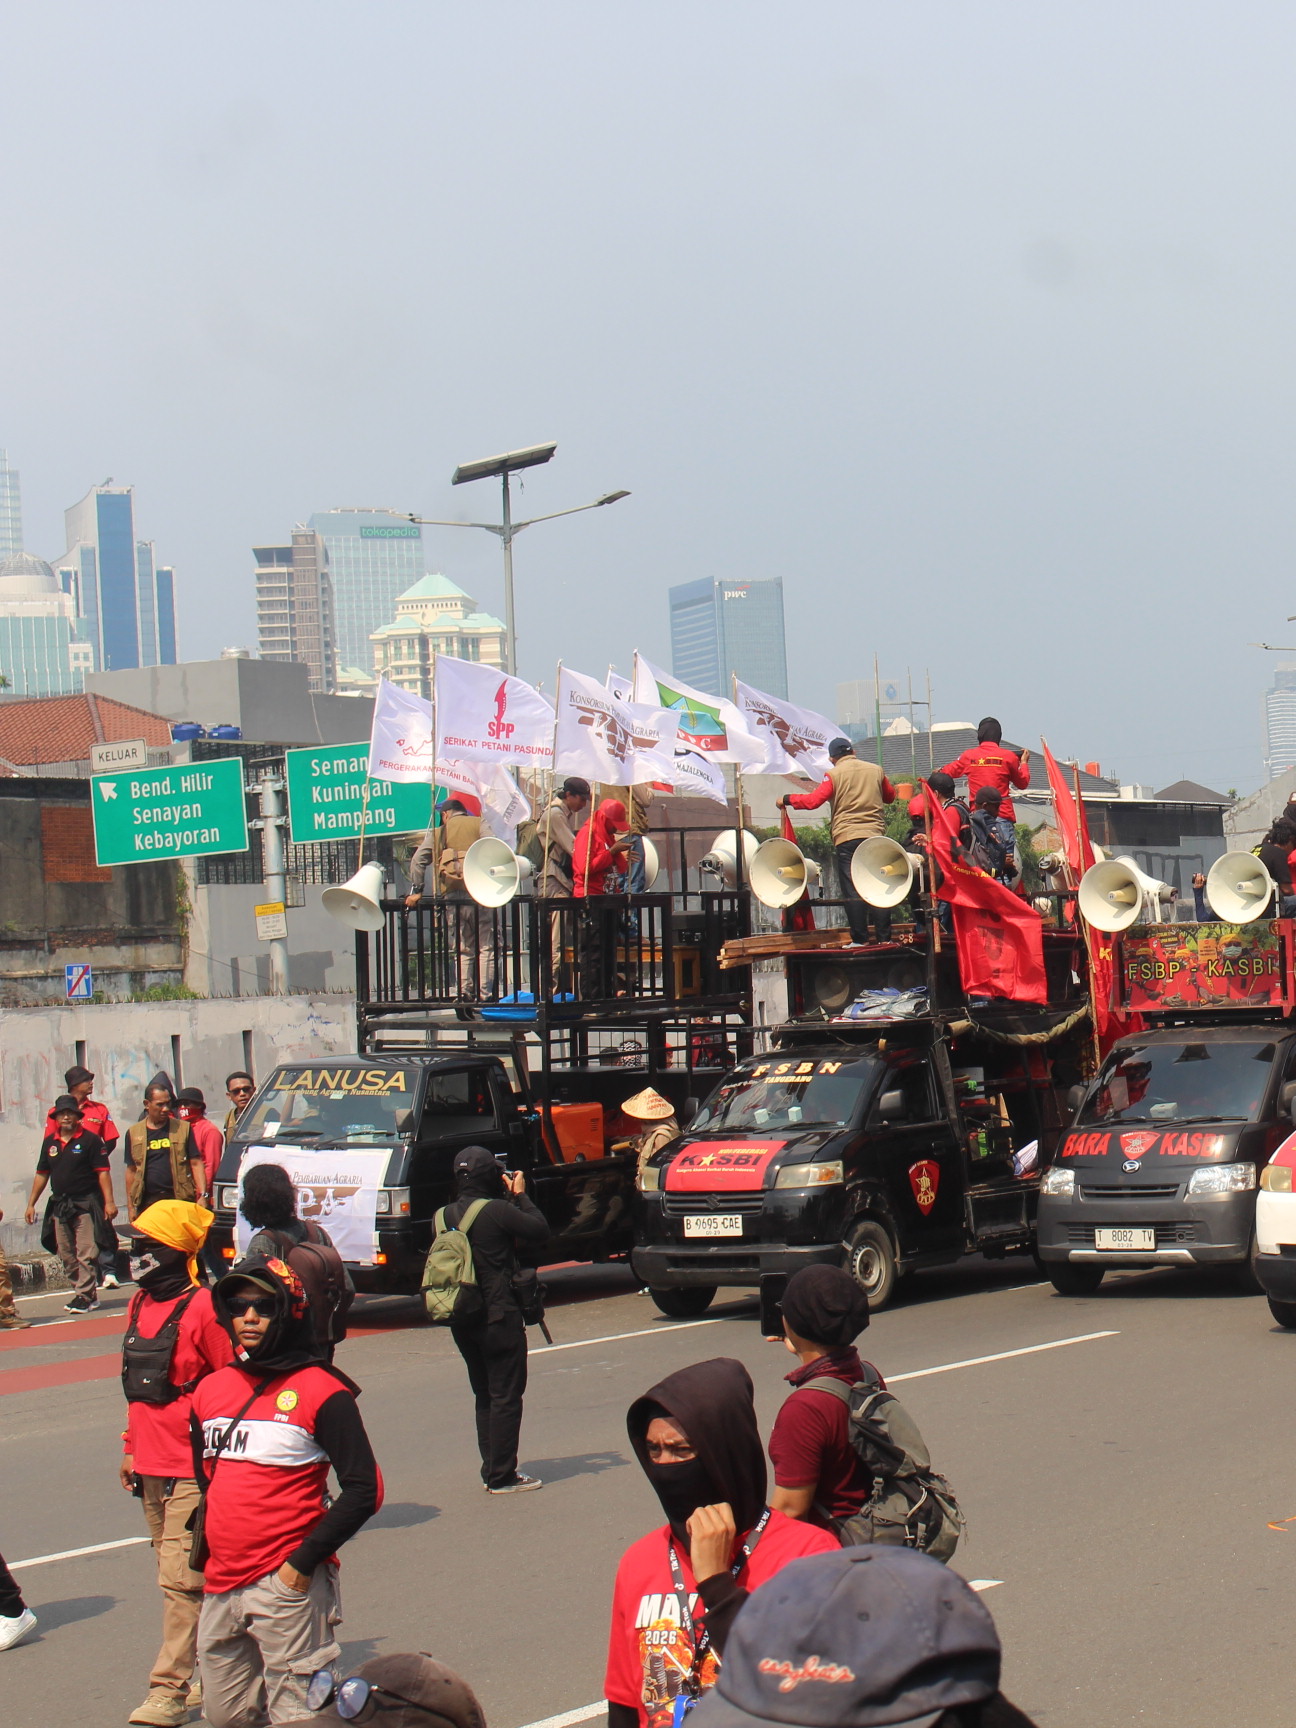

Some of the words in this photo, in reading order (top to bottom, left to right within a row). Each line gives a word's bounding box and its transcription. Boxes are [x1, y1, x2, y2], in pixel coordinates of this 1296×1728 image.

[362, 526, 419, 539] tokopedia
[724, 590, 747, 600] pwc
[487, 721, 515, 739] SPP
[631, 722, 661, 738] AGRARIA
[803, 727, 828, 742] AGRARIA
[98, 748, 138, 762] KELUAR
[443, 736, 478, 749] SERIKAT
[481, 741, 511, 753] PETANI
[514, 744, 555, 756] PASUNDA
[311, 753, 369, 777] Seman
[379, 760, 433, 773] PERGERAKAN
[435, 766, 461, 781] PETANI
[676, 762, 714, 784] MAJALENGKA
[130, 777, 176, 799] Bend.
[180, 773, 213, 793] Hilir
[312, 780, 392, 805] Kuningan
[133, 803, 202, 826] Senayan
[314, 807, 396, 831] Mampang
[134, 827, 220, 852] Kebayoran
[1127, 961, 1180, 981] FSBP
[1207, 957, 1274, 977] KASBI
[274, 1070, 406, 1091] LANUSA
[763, 1076, 813, 1084] TANGERANG
[284, 1088, 318, 1096] Lumbung
[320, 1088, 348, 1096] Agraria
[350, 1088, 391, 1096] Nusantara
[150, 1138, 171, 1150] ara
[1062, 1132, 1112, 1158] BARA
[1159, 1132, 1224, 1158] KASBI
[679, 1153, 763, 1166] KASBI
[292, 1171, 332, 1184] PEMBARUAN
[332, 1172, 363, 1185] AGRARIA
[685, 1218, 692, 1230] B
[696, 1217, 719, 1229] 9695
[722, 1216, 740, 1229] CAE
[1097, 1230, 1103, 1241] T
[1111, 1229, 1133, 1241] 8082
[1141, 1230, 1153, 1241] TV
[755, 1510, 771, 1532] TikTok
[669, 1549, 679, 1571] TikTok
[645, 1631, 677, 1645] 2026
